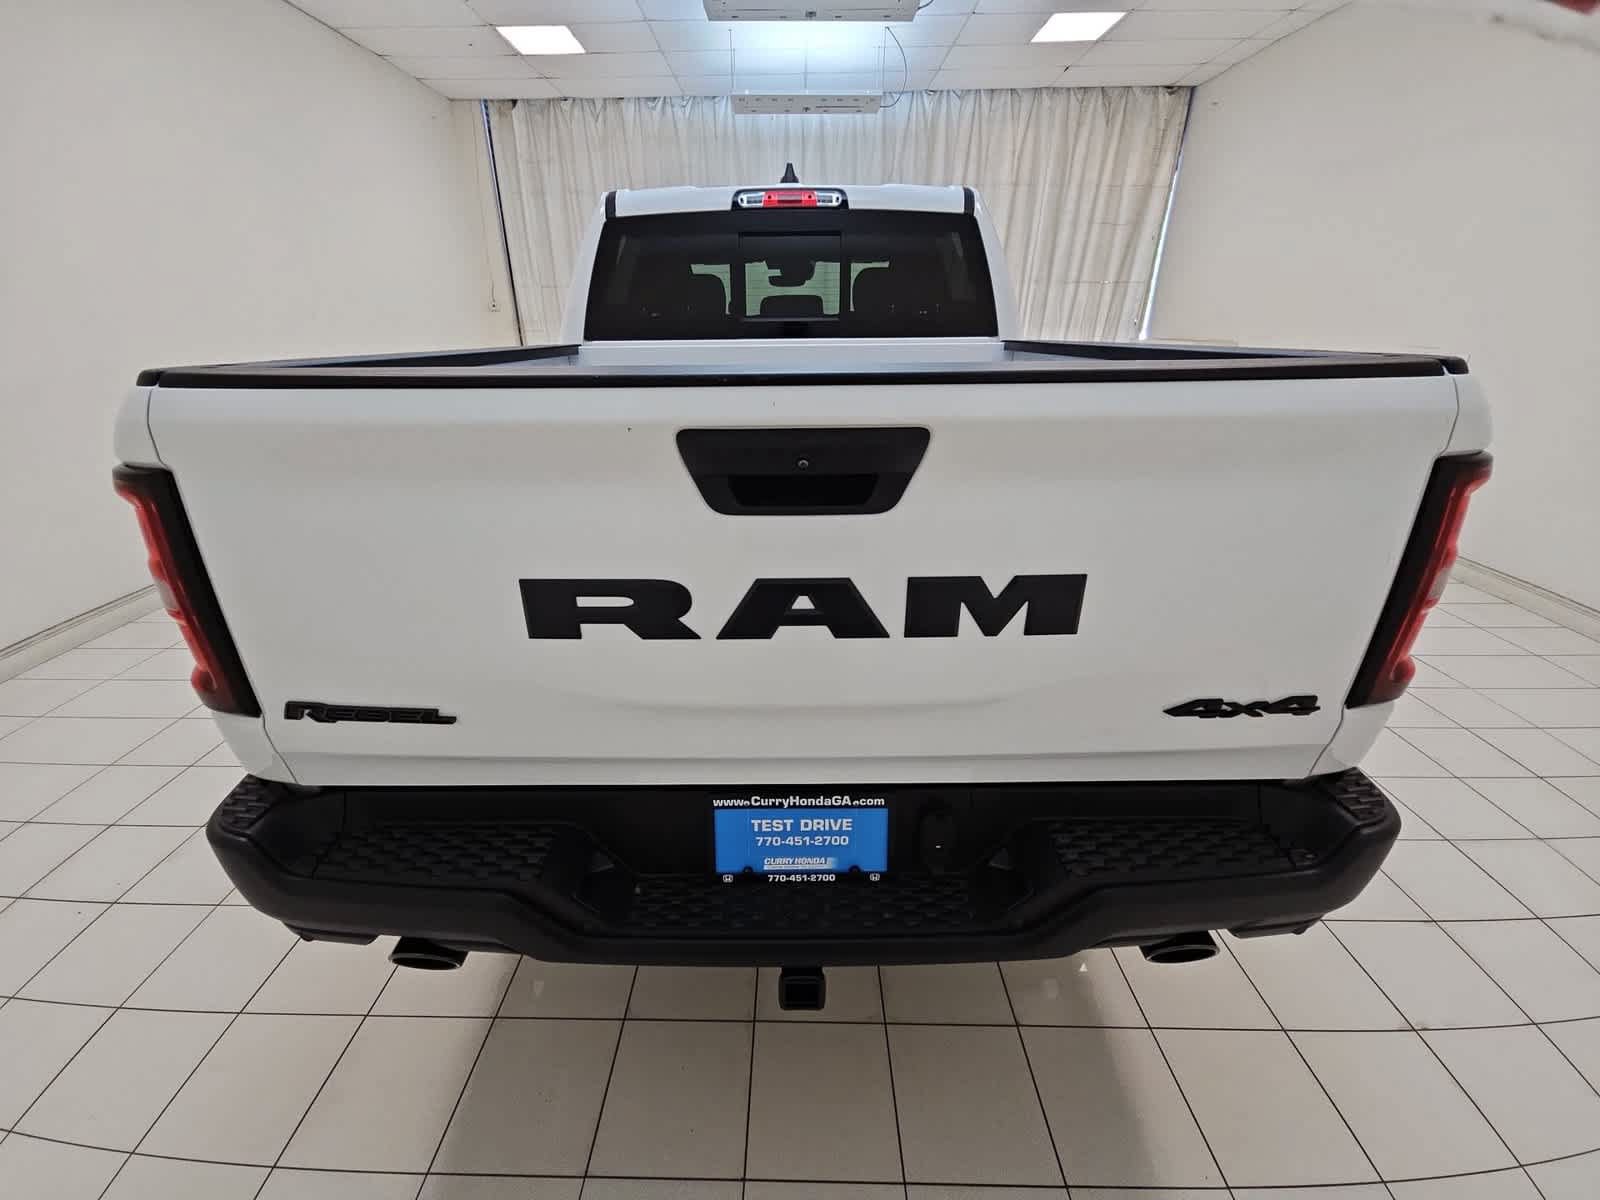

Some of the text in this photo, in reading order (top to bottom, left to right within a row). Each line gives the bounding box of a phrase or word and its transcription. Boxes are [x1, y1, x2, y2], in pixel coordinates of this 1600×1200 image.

[519, 573, 1088, 641] RAM
[751, 818, 853, 832] TEST DRIVE
[756, 836, 849, 846] 770-451-2700
[767, 874, 836, 882] 770-451-2700
